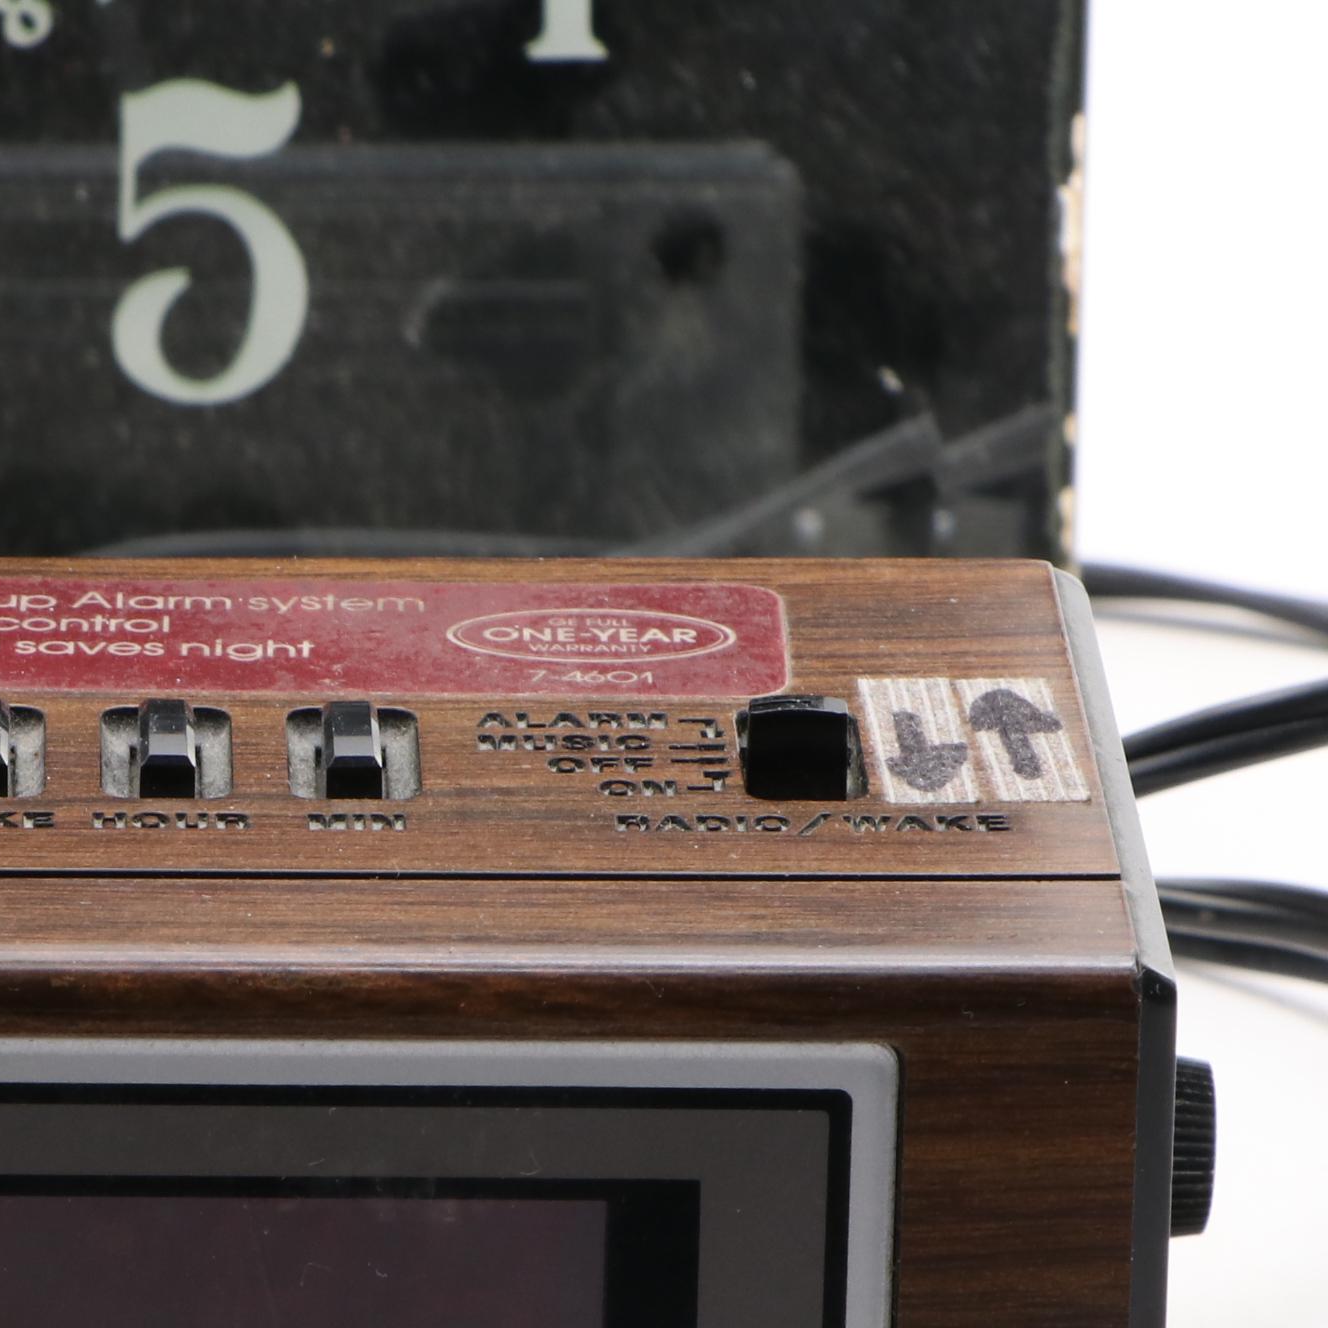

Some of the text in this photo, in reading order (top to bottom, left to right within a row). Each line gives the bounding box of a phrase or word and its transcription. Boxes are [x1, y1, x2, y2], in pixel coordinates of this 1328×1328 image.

[111, 78, 310, 405] 5
[72, 591, 234, 612] Alarm
[248, 594, 426, 615] system
[482, 626, 698, 644] ONE-YEAR
[14, 640, 166, 657] saves
[179, 640, 316, 663] night
[527, 642, 653, 654] WARRANTY
[530, 668, 655, 686] 7-4601
[476, 711, 670, 731] ALARM
[476, 734, 651, 752] MUSIC
[547, 756, 656, 775] OFF
[598, 779, 678, 797] ON
[92, 812, 252, 830] HOUR
[307, 813, 408, 831] MIN
